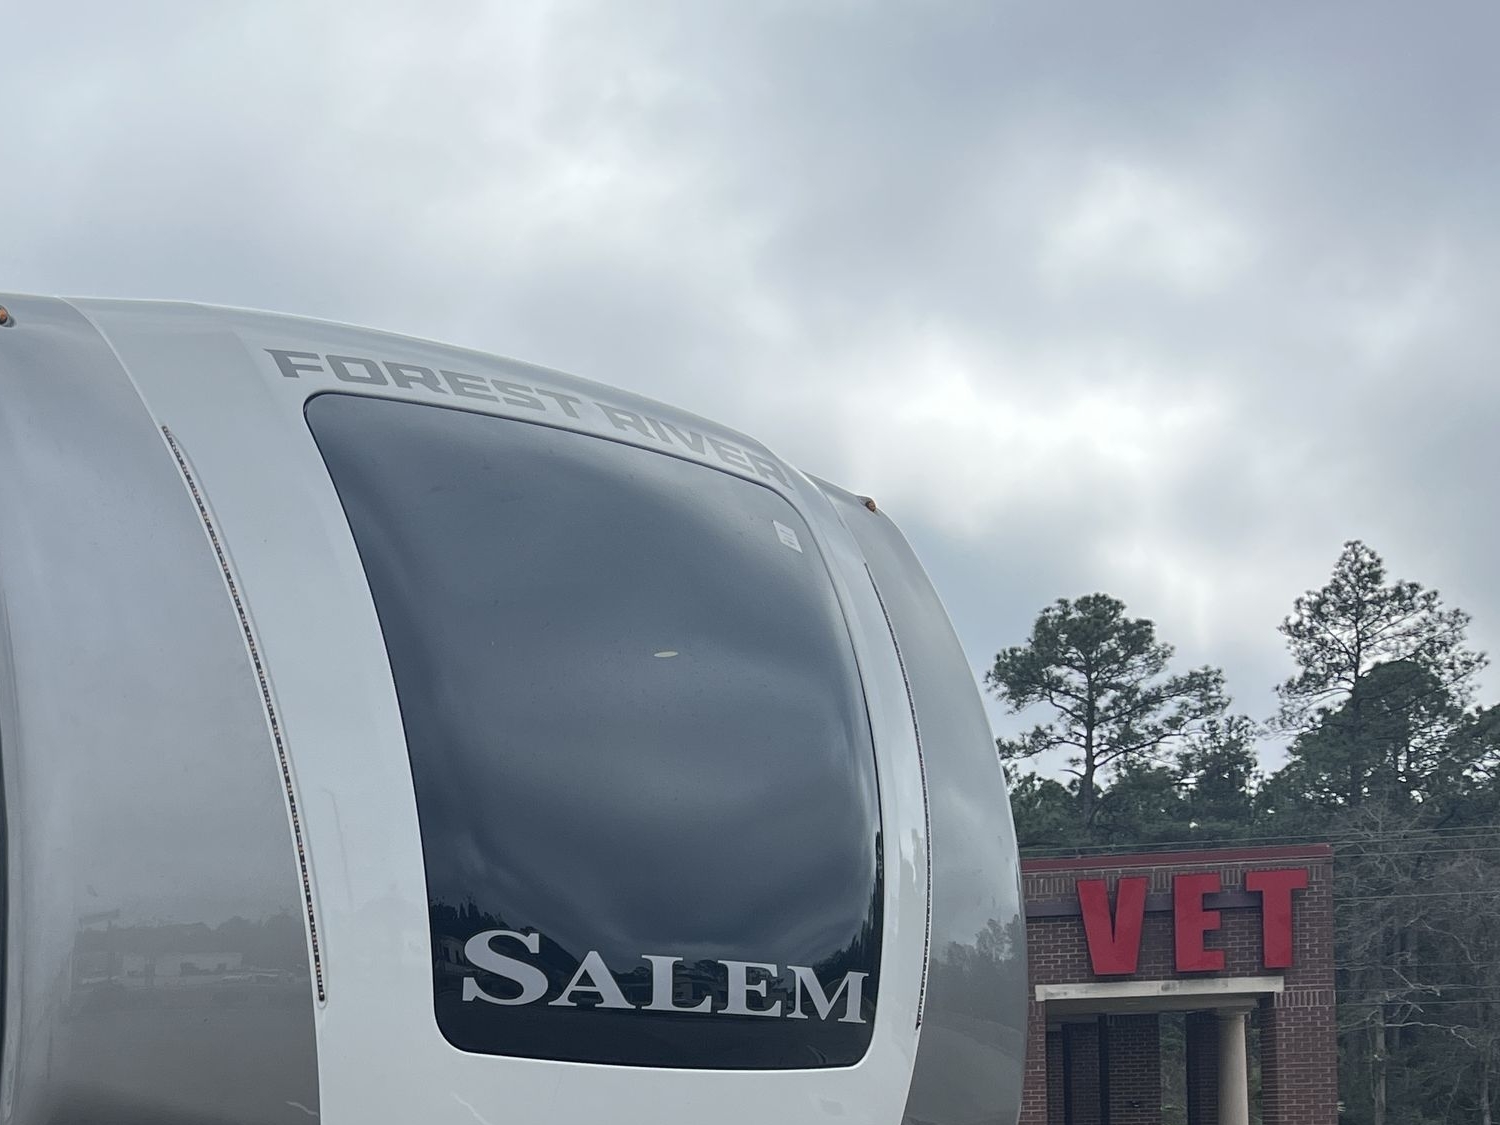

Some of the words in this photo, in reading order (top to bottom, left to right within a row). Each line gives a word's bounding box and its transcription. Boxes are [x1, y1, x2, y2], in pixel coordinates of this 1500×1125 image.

[263, 348, 581, 419] FOREST
[593, 402, 795, 491] RIVER
[1076, 868, 1308, 976] VET
